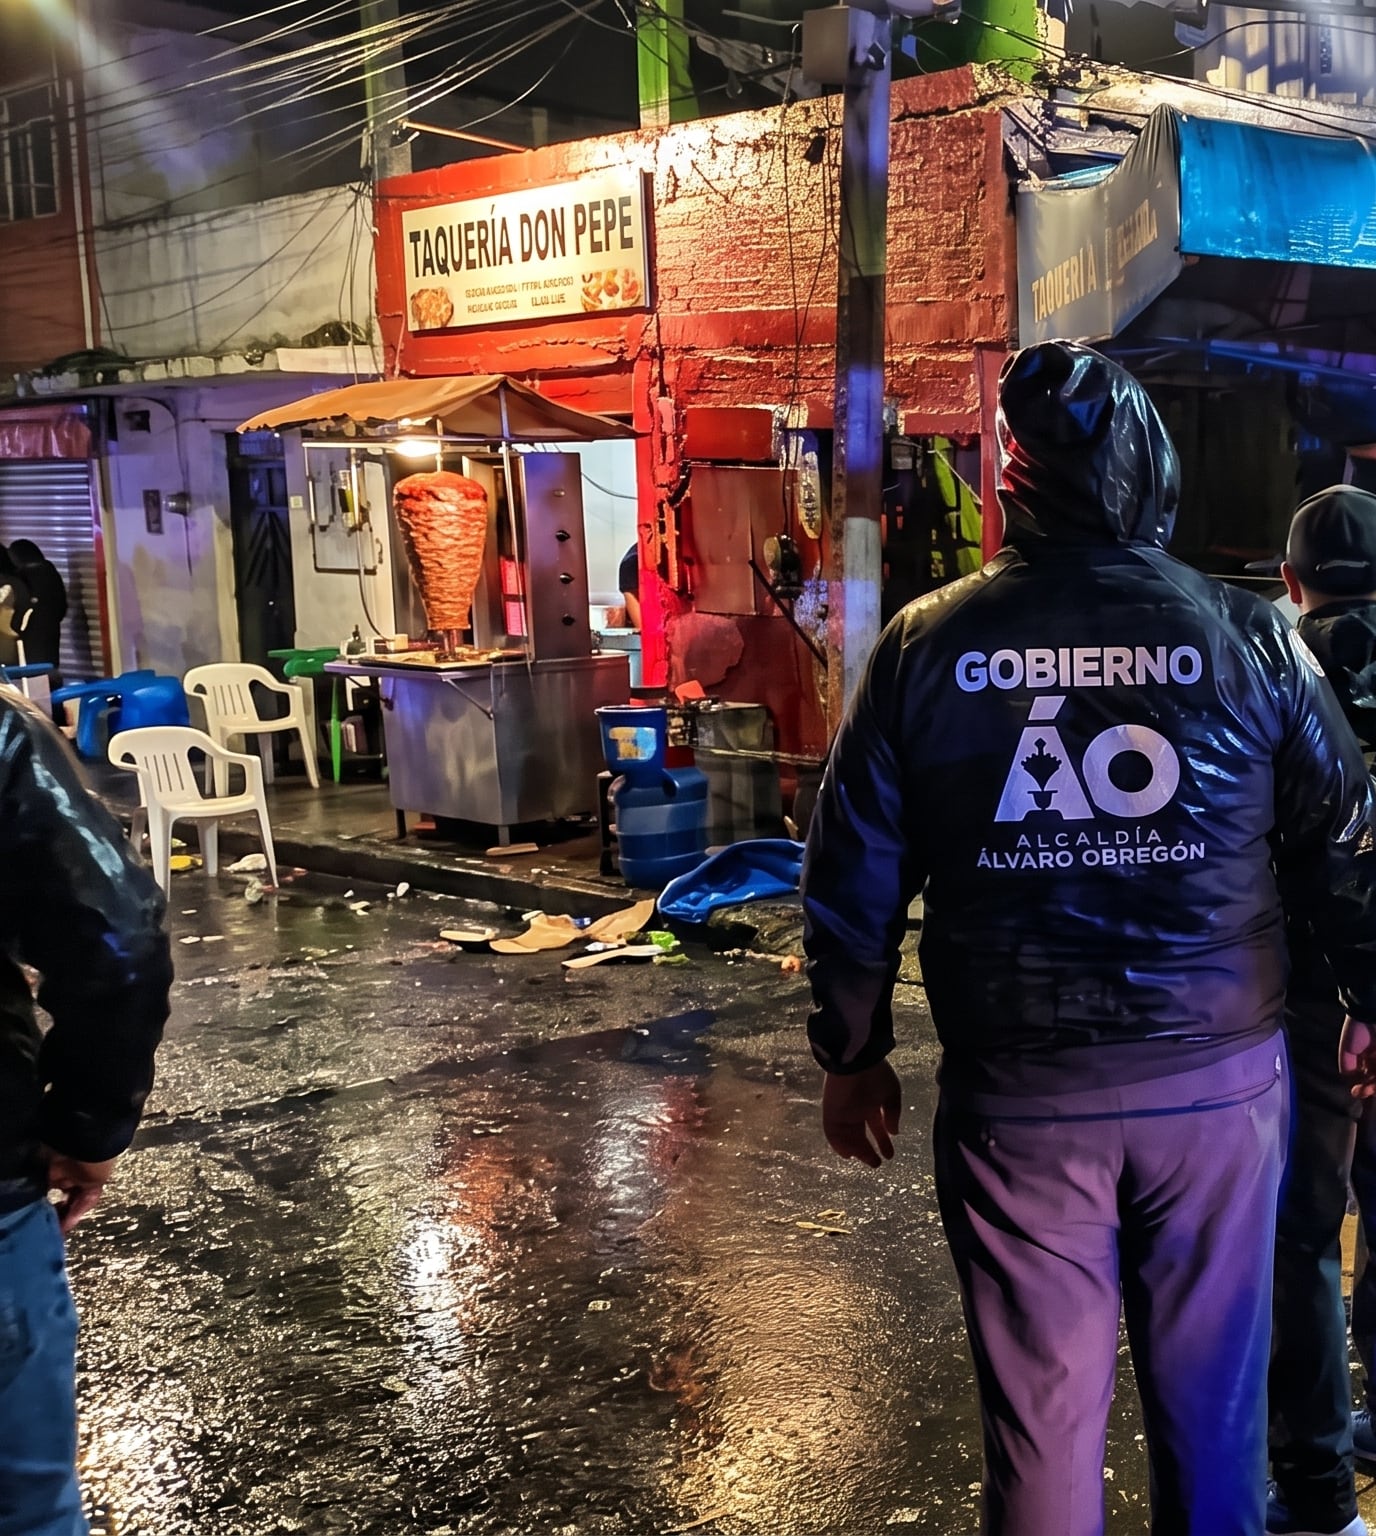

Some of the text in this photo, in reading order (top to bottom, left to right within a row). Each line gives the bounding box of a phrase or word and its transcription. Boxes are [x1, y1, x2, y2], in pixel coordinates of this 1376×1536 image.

[409, 196, 633, 278] TAQUERÍA DON PEPE
[955, 645, 1202, 692] GOBIERNO
[994, 695, 1180, 822] ÁO
[977, 840, 1205, 869] ÁLVARO OBREGÓN
[1016, 826, 1161, 848] ALCALDÍA
